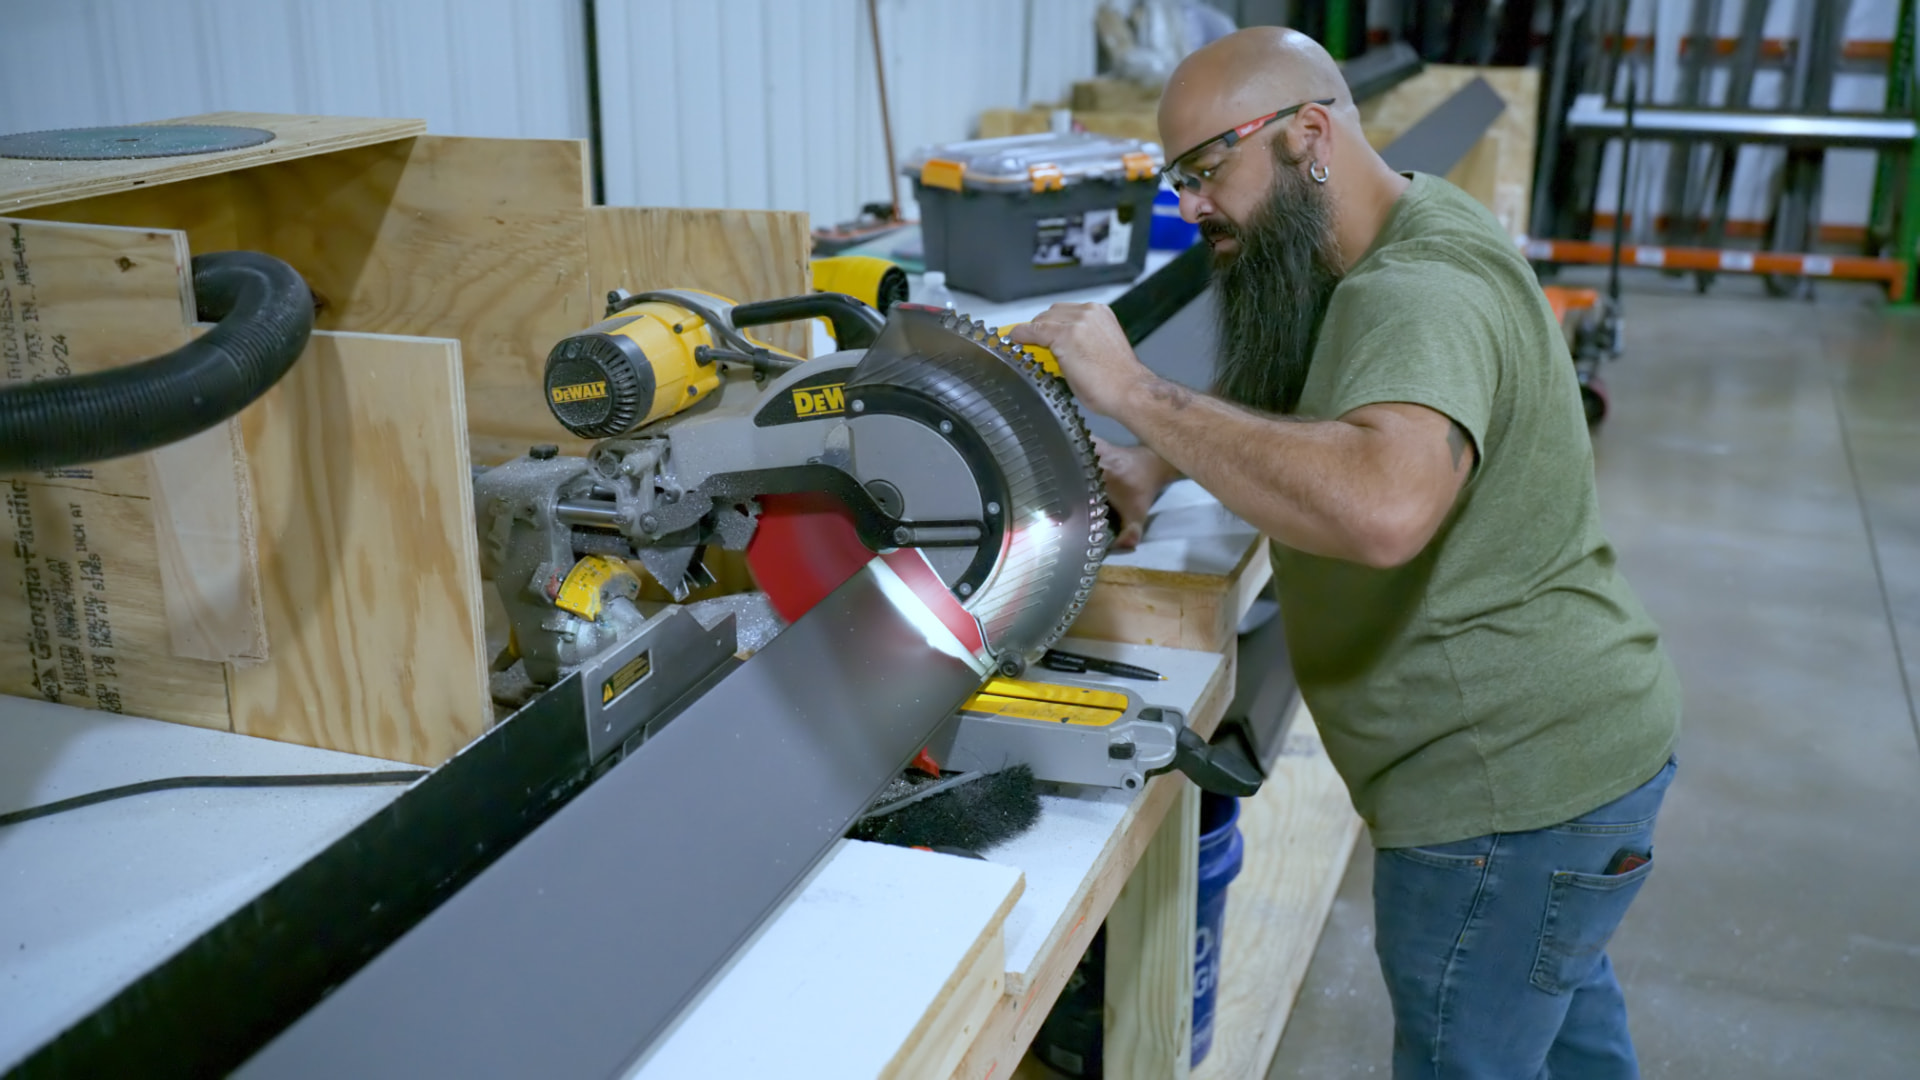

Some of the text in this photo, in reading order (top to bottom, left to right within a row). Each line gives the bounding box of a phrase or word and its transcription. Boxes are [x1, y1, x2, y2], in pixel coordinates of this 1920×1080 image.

[52, 333, 71, 377] 8/24
[551, 381, 607, 403] DEWALT
[793, 386, 845, 415] DEW
[69, 502, 82, 518] AT
